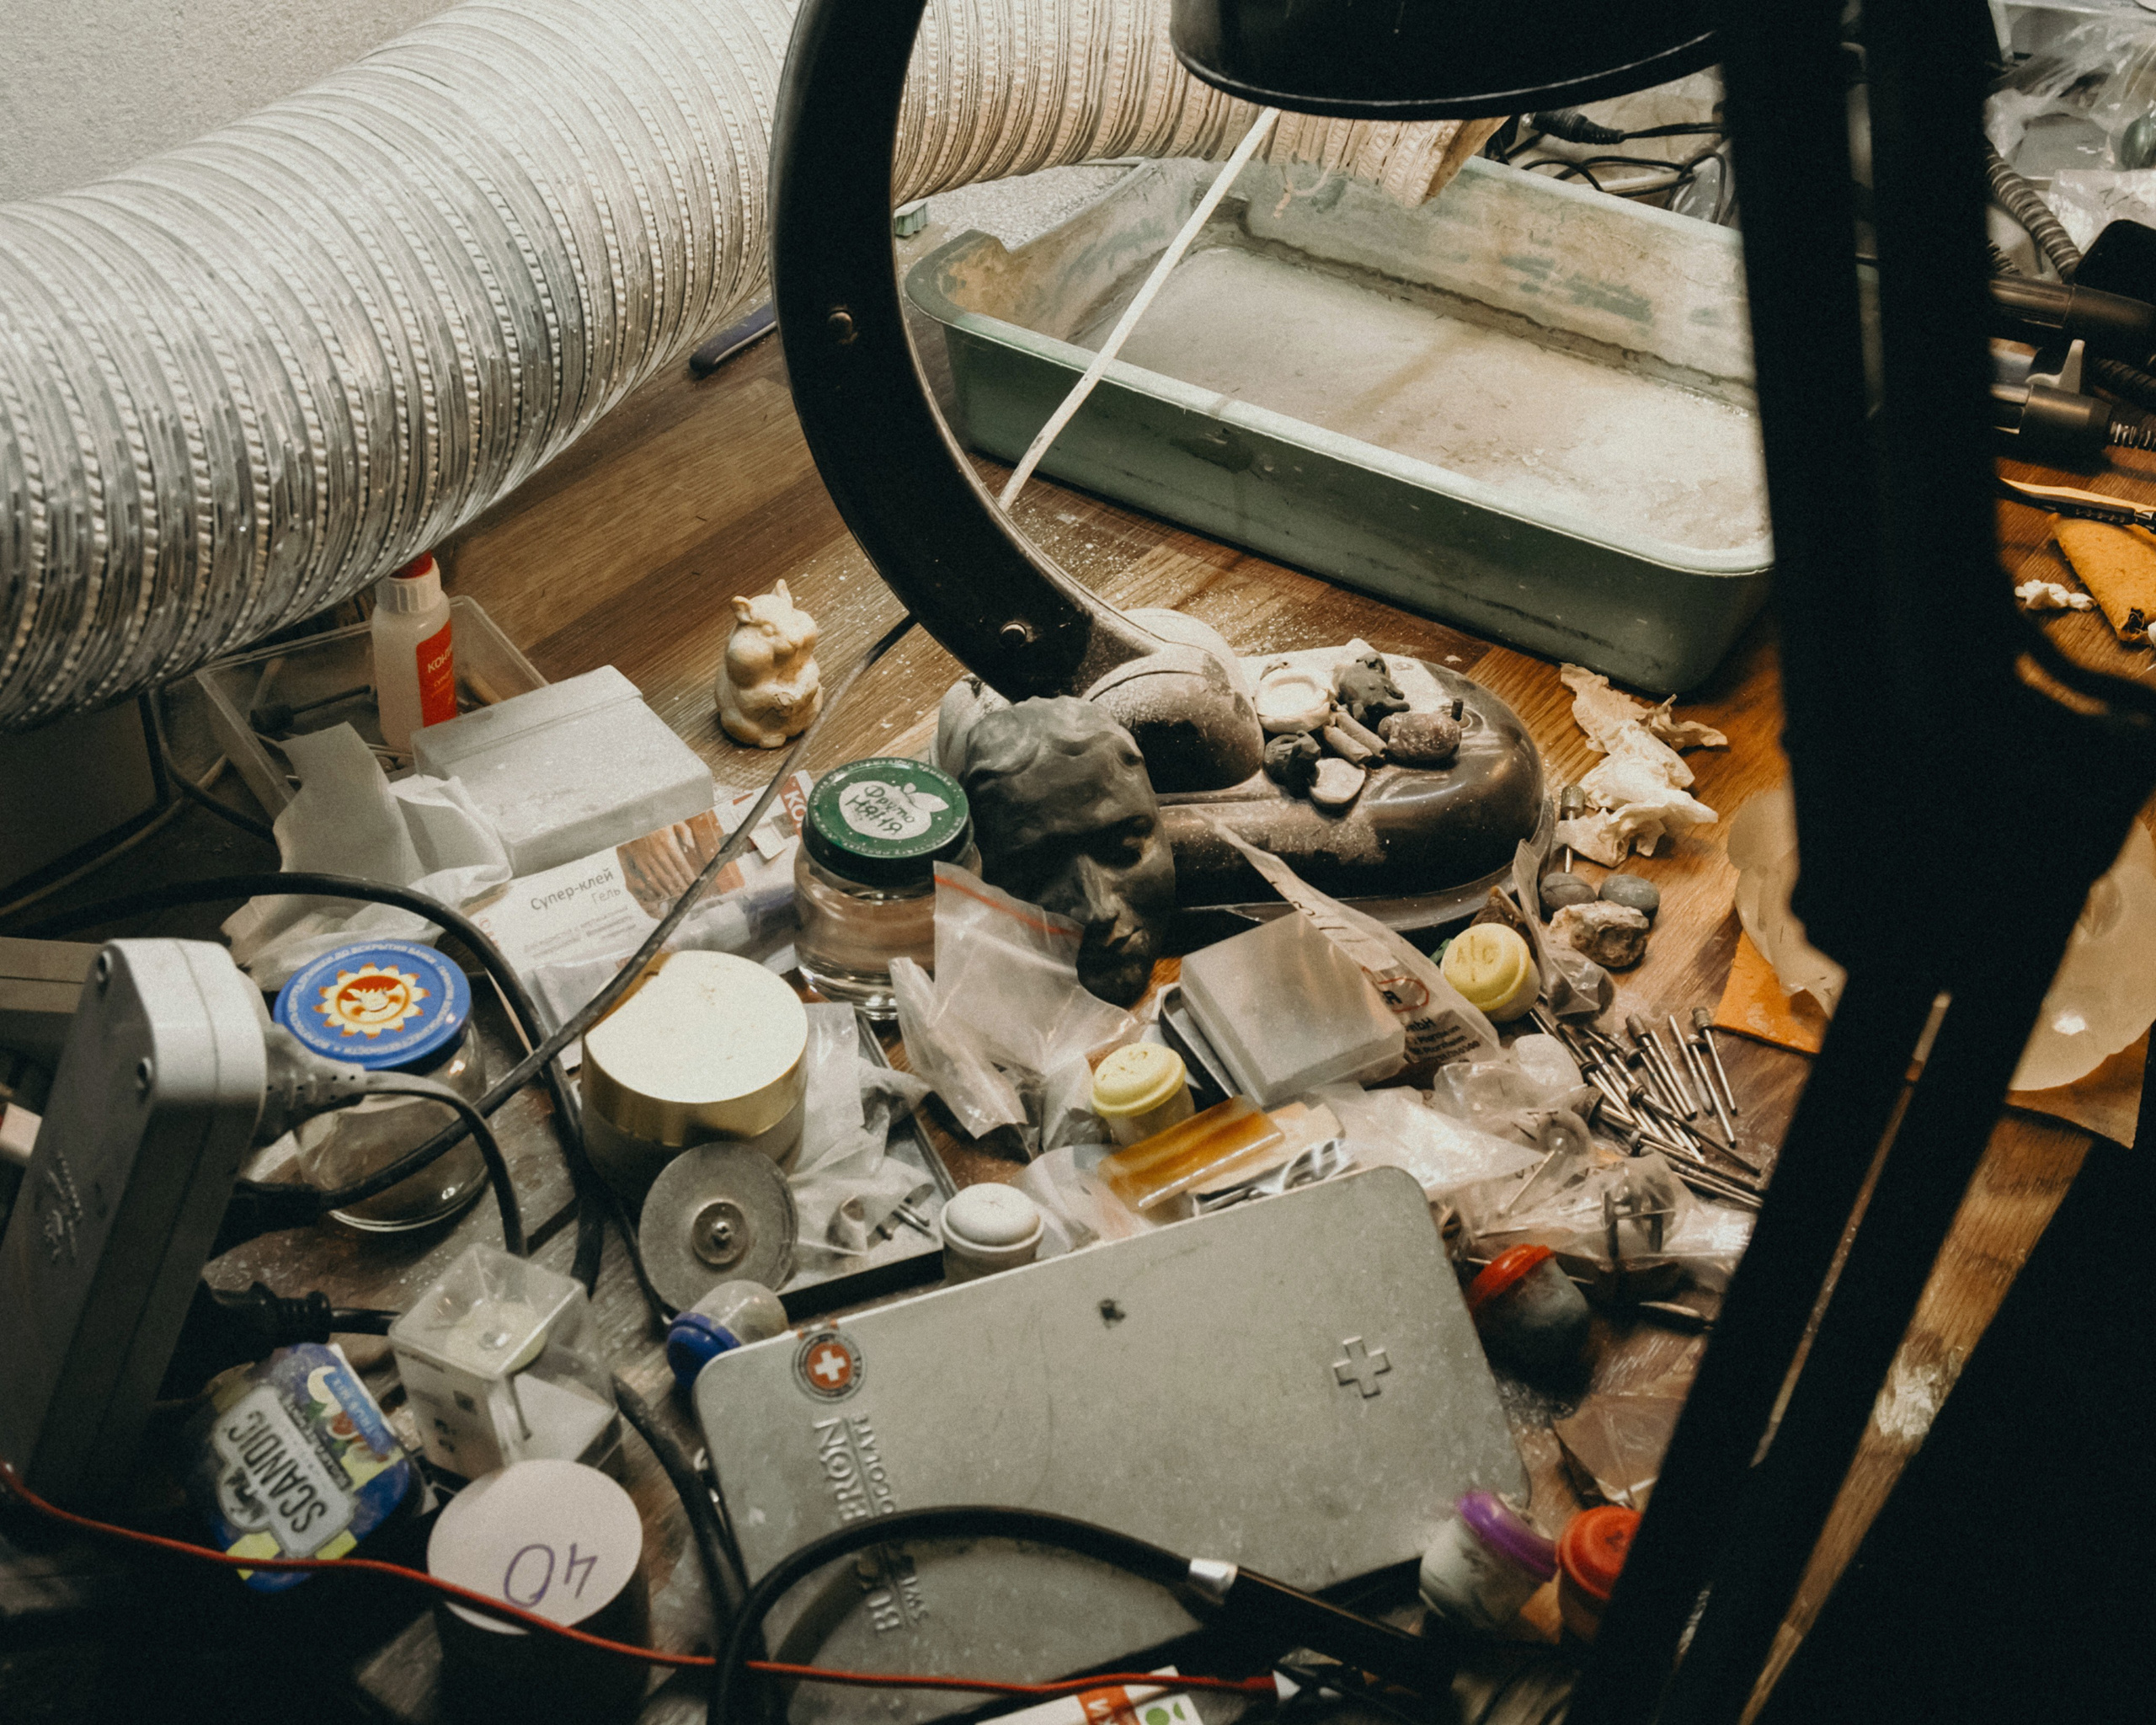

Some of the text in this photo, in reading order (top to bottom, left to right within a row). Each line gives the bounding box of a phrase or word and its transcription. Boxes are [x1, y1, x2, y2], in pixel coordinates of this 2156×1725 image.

[530, 867, 615, 911] Супер-клей
[590, 886, 622, 905] Гель
[227, 1409, 328, 1534] SCANDIC
[503, 1542, 599, 1609] 40
